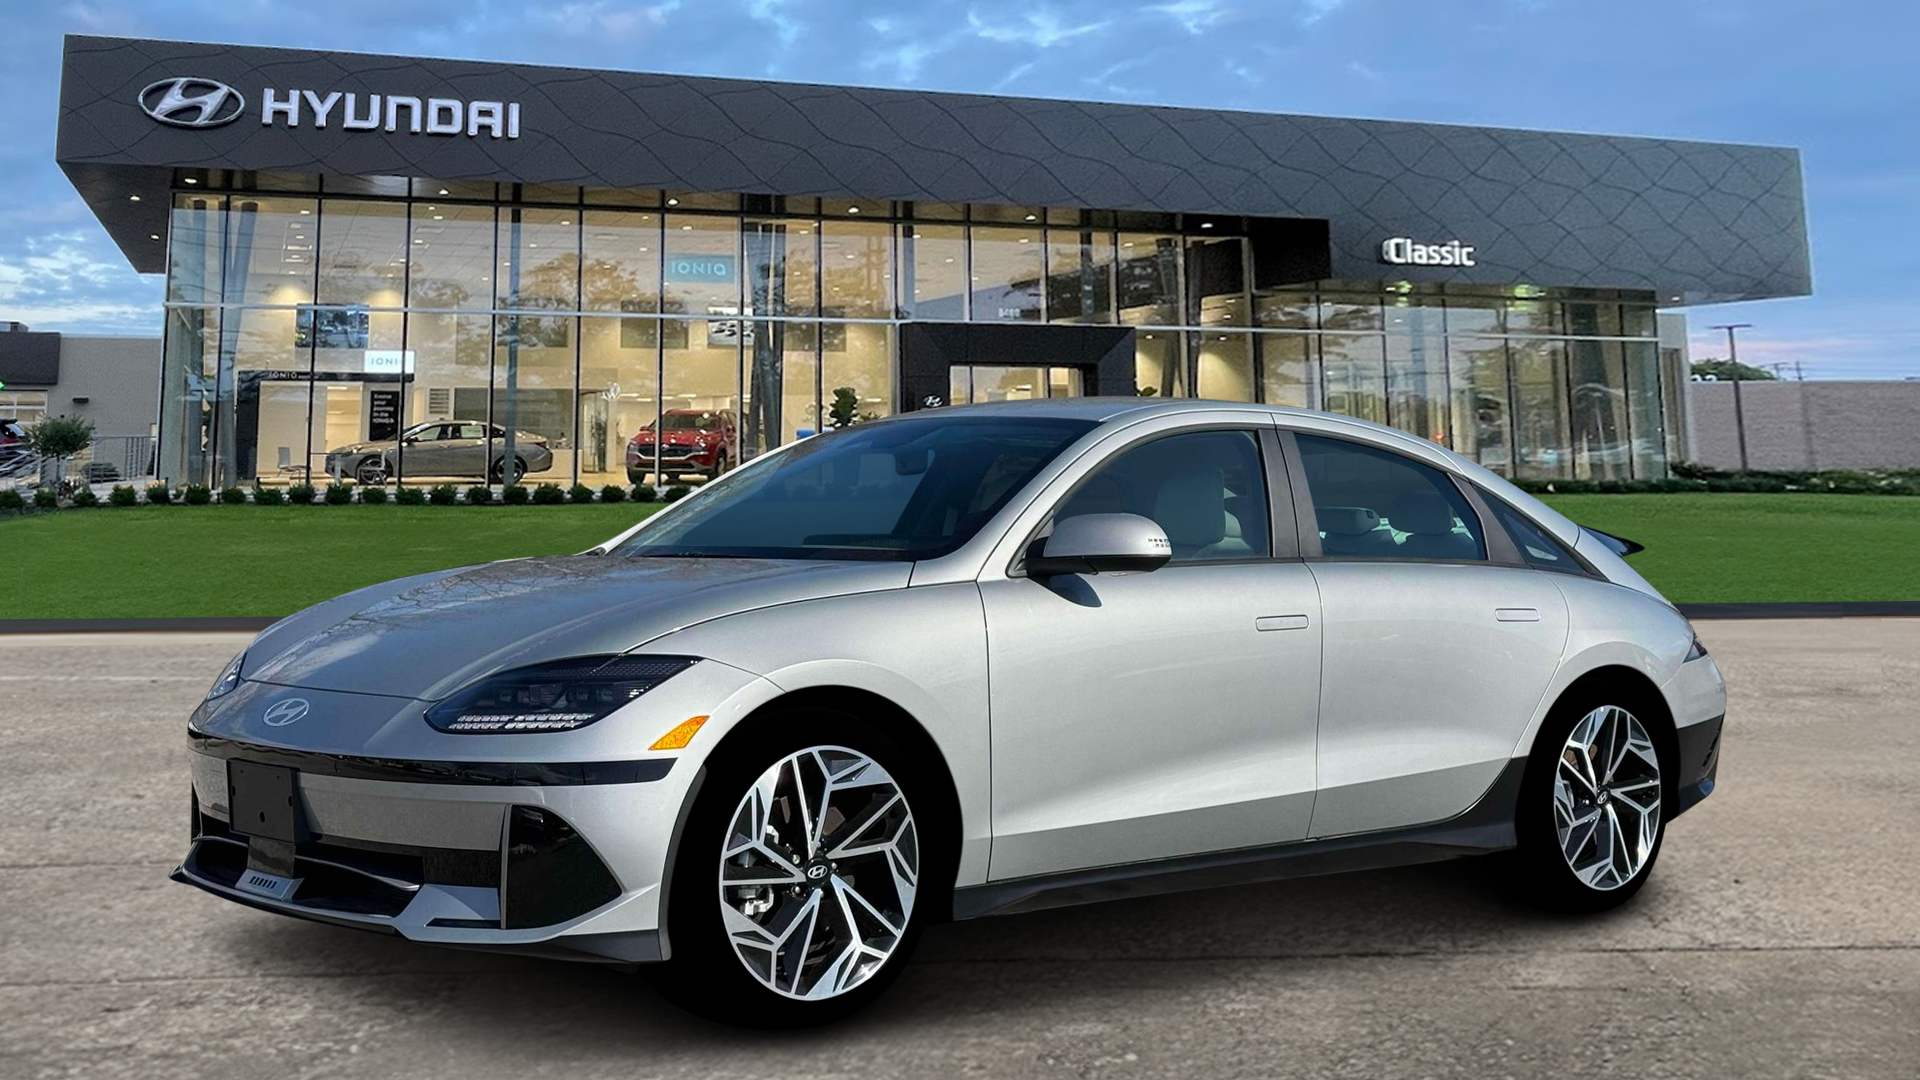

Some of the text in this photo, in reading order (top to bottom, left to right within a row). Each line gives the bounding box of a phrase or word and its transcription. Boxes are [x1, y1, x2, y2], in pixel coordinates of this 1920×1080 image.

[261, 88, 520, 140] HYUNDAI
[1382, 237, 1476, 267] Classic
[671, 261, 726, 276] IONIQ
[371, 357, 402, 366] IONI
